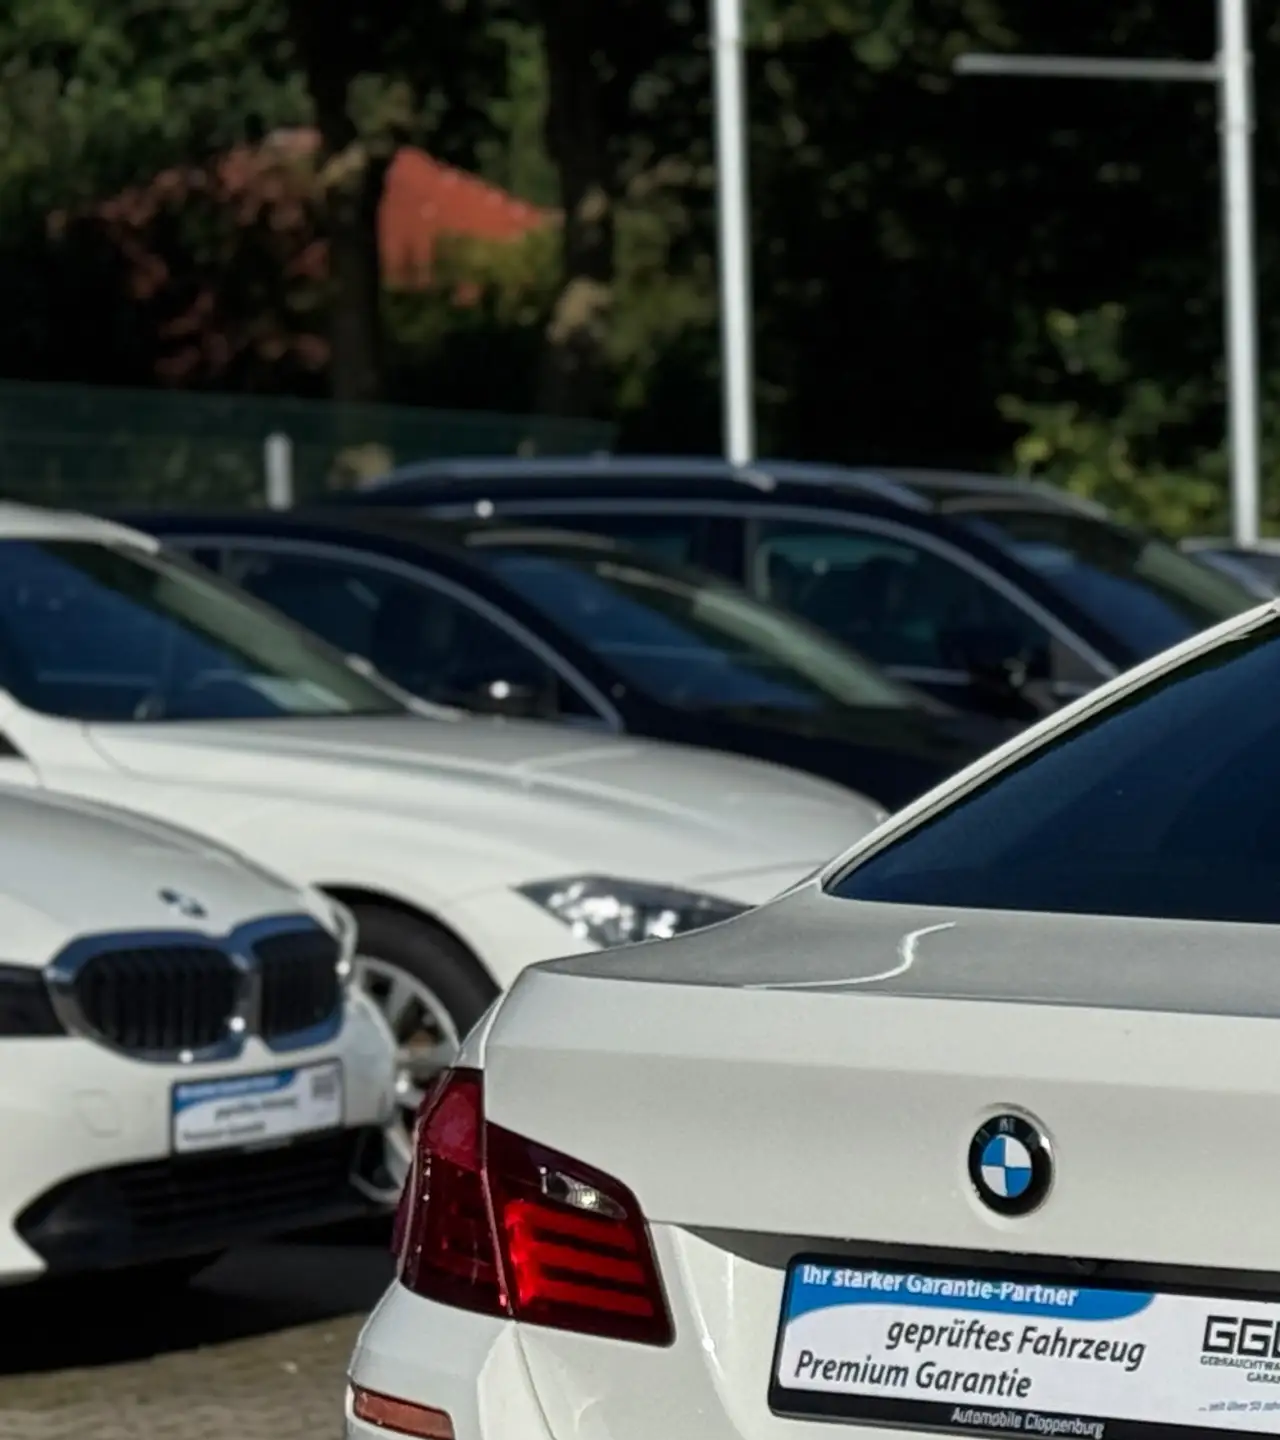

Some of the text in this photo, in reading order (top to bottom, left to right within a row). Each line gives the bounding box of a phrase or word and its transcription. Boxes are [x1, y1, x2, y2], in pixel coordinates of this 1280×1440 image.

[803, 1263, 1079, 1306] Ihr starker Garantie-Partner
[885, 1319, 1147, 1373] geprüftes Fahrzeug
[794, 1349, 1033, 1398] Premium Garantie
[951, 1405, 1105, 1440] Automobile Cloppenburg
